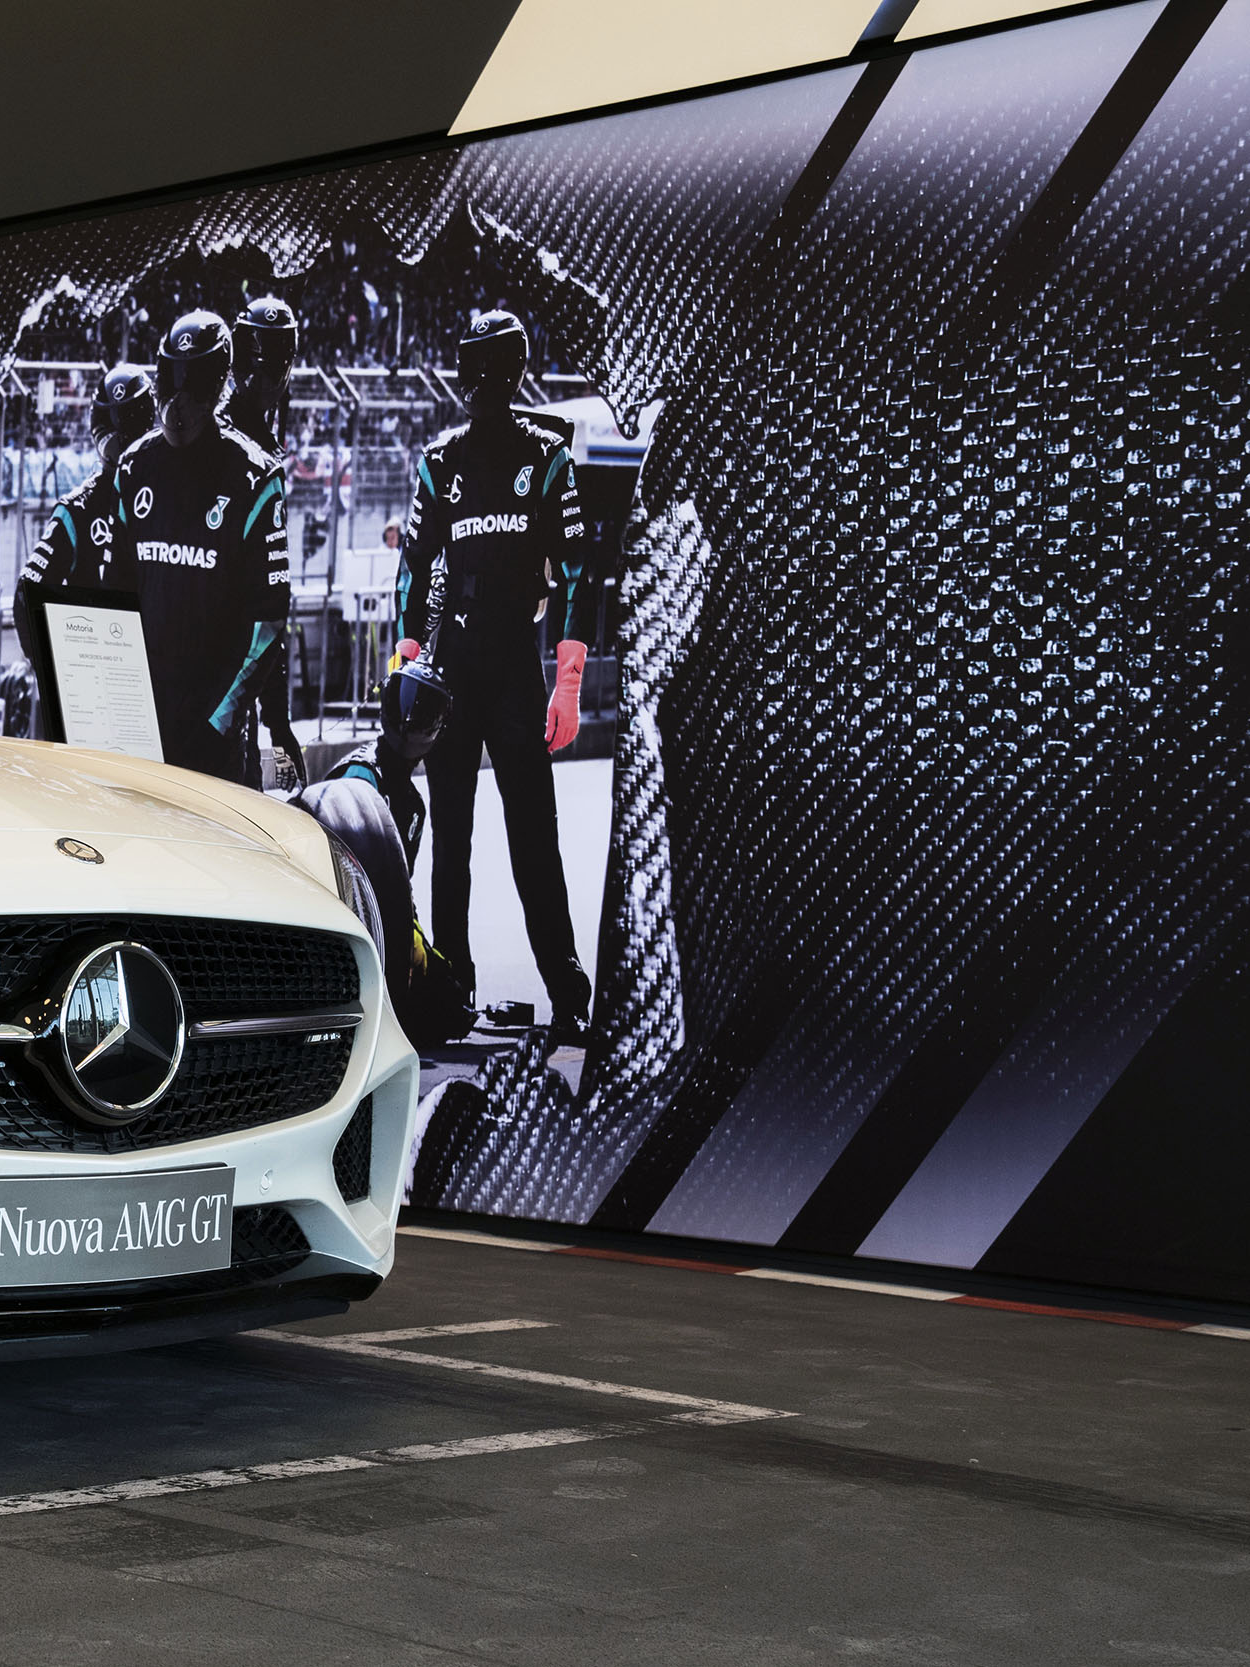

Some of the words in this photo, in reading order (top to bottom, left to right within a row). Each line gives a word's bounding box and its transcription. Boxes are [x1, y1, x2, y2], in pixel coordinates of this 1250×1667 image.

[136, 541, 218, 569] PETRONAS
[65, 622, 95, 633] Motoria
[110, 1198, 186, 1252] AMG
[191, 1193, 227, 1244] GT
